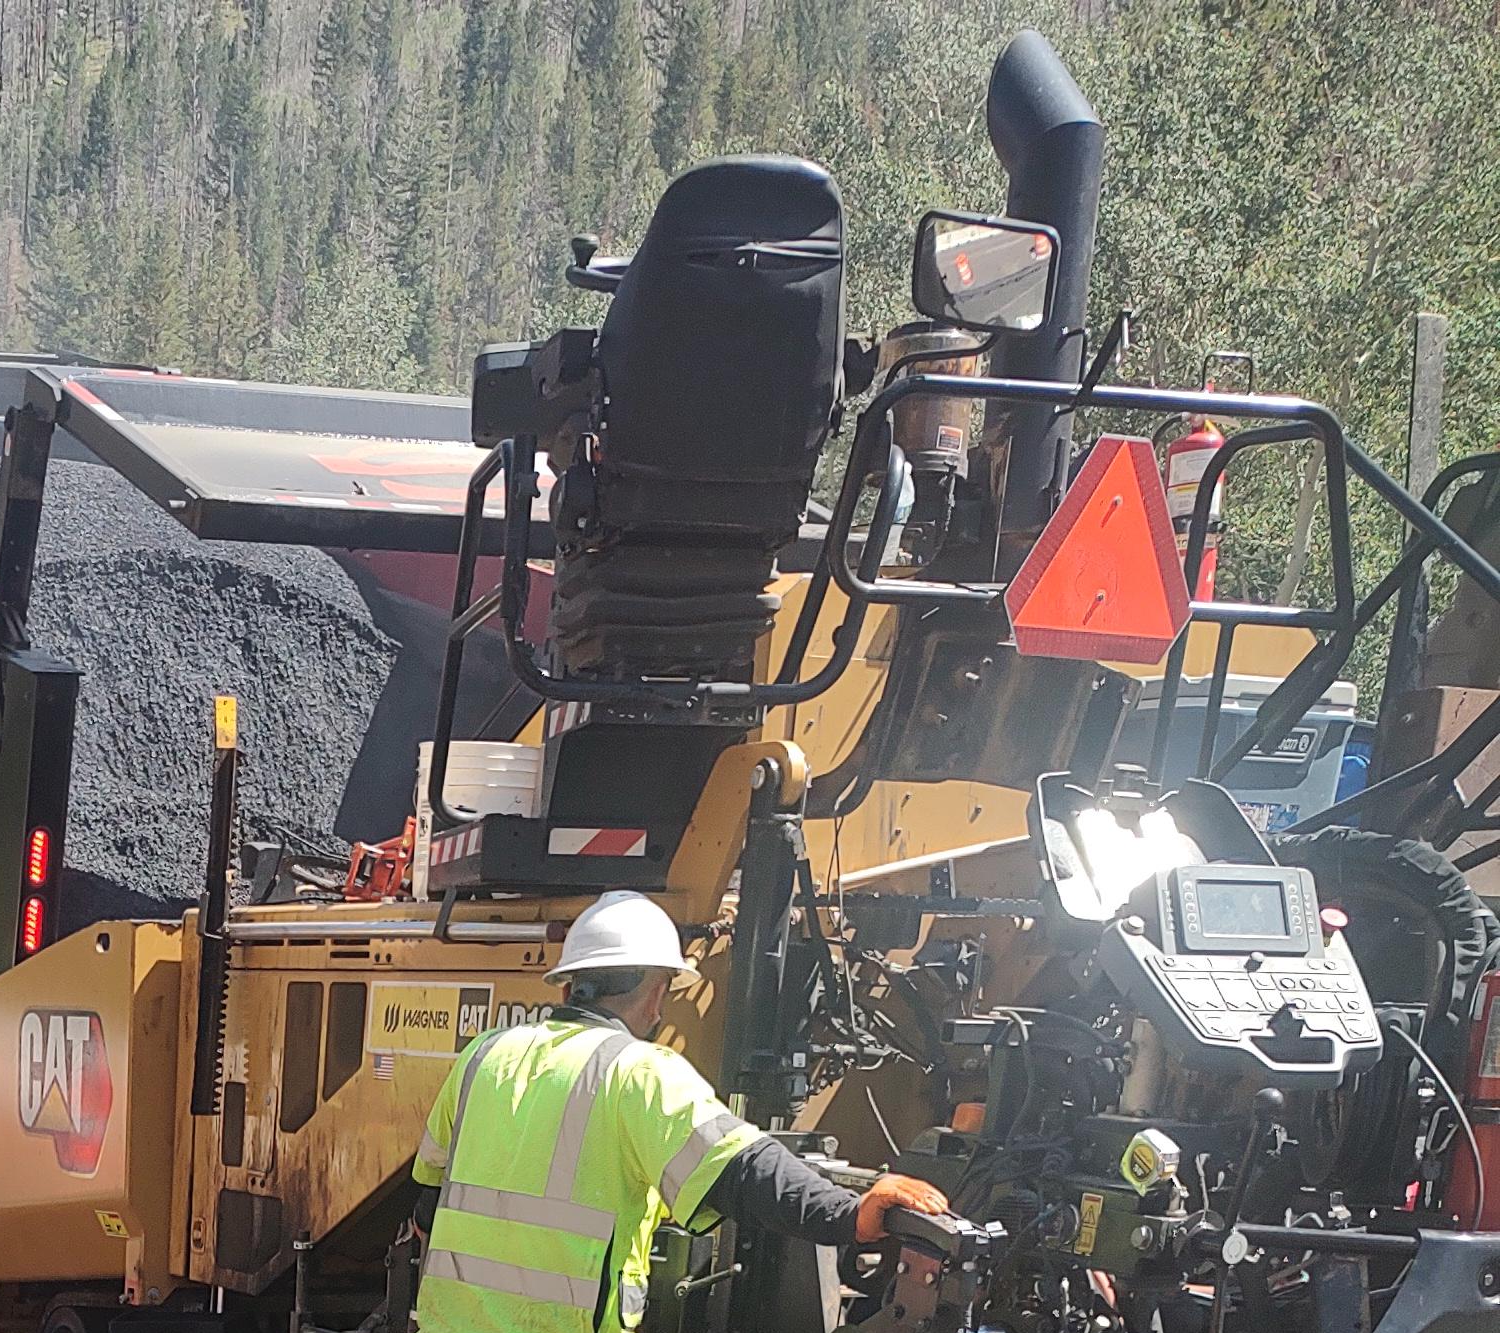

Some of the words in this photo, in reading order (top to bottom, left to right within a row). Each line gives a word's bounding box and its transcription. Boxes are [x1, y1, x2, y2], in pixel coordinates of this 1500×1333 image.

[403, 1009, 449, 1030] WAGNER
[459, 1004, 488, 1037] CAT
[20, 1012, 90, 1133] CAT
